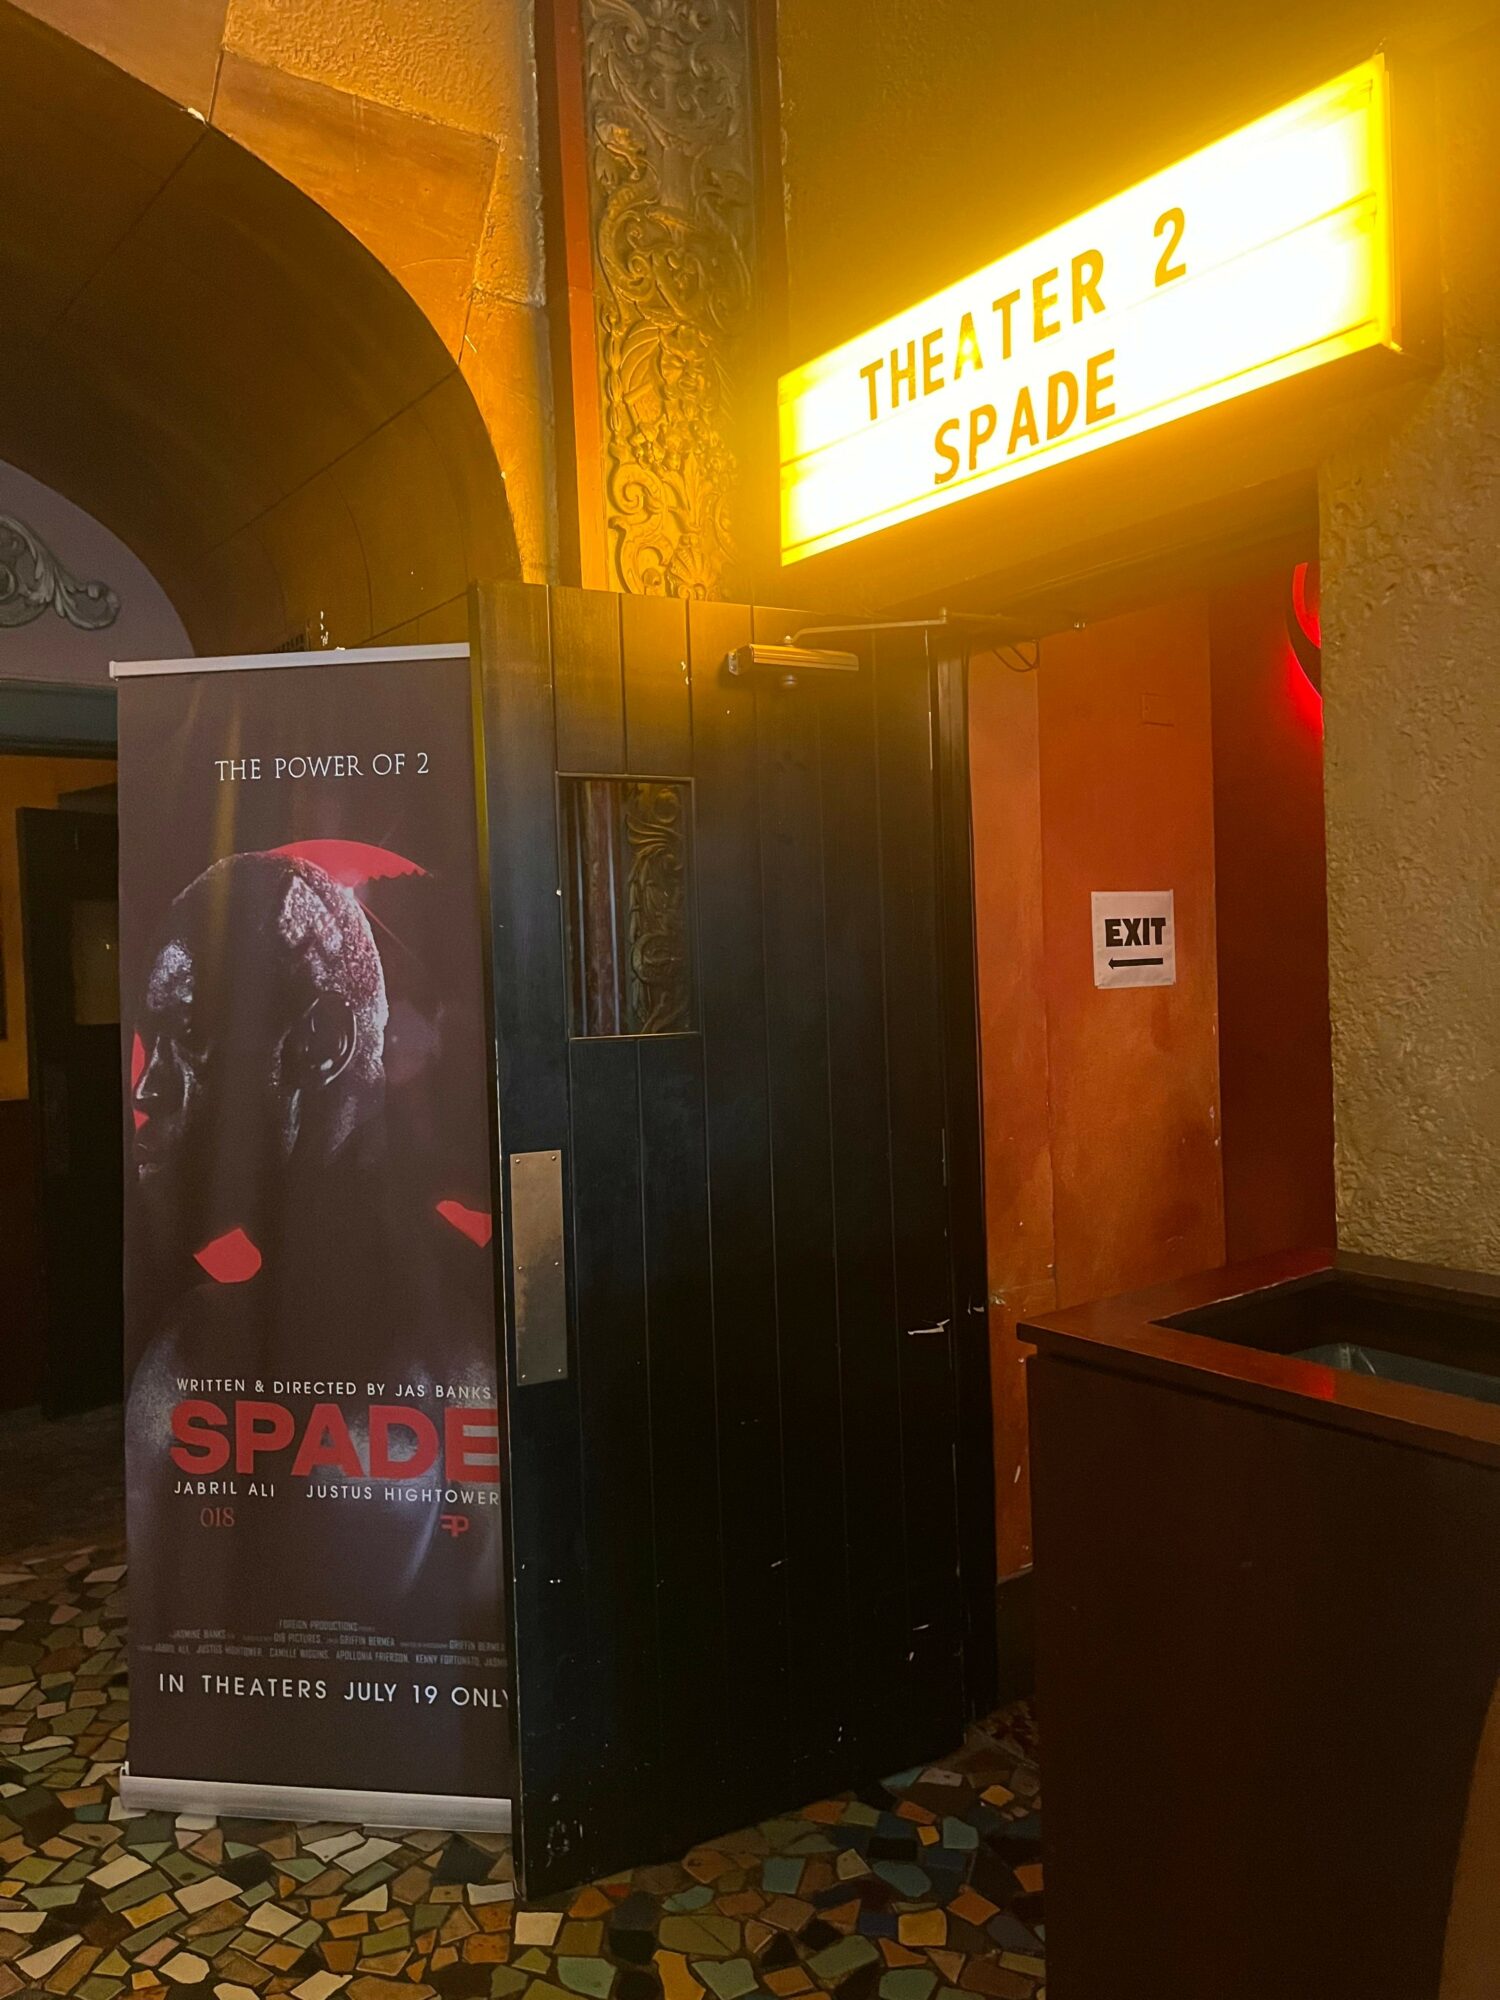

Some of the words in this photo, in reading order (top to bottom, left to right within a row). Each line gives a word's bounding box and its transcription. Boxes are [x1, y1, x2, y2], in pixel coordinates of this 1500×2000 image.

[859, 248, 1106, 421] THEATER
[1153, 207, 1187, 288] 2
[934, 348, 1116, 485] SPADE
[215, 758, 262, 781] THE
[274, 755, 364, 779] POWER
[372, 753, 405, 776] OF
[417, 752, 429, 774] 2
[1105, 917, 1166, 947] EXIT
[177, 1378, 245, 1392] WRITTEN
[255, 1380, 264, 1393] &
[273, 1381, 357, 1395] DIRECTED
[367, 1383, 385, 1396] BY
[395, 1384, 426, 1398] JAS
[435, 1385, 492, 1400] BANKS
[170, 1399, 500, 1483] SPADE
[174, 1481, 238, 1496] JABRIL
[248, 1483, 275, 1497] ALI
[306, 1485, 373, 1500] JUSTUS
[384, 1487, 499, 1505] HIGHTOWER
[159, 1673, 184, 1693] IN
[202, 1675, 327, 1699] THEATERS
[344, 1681, 397, 1703] JULY
[413, 1685, 438, 1705] 19
